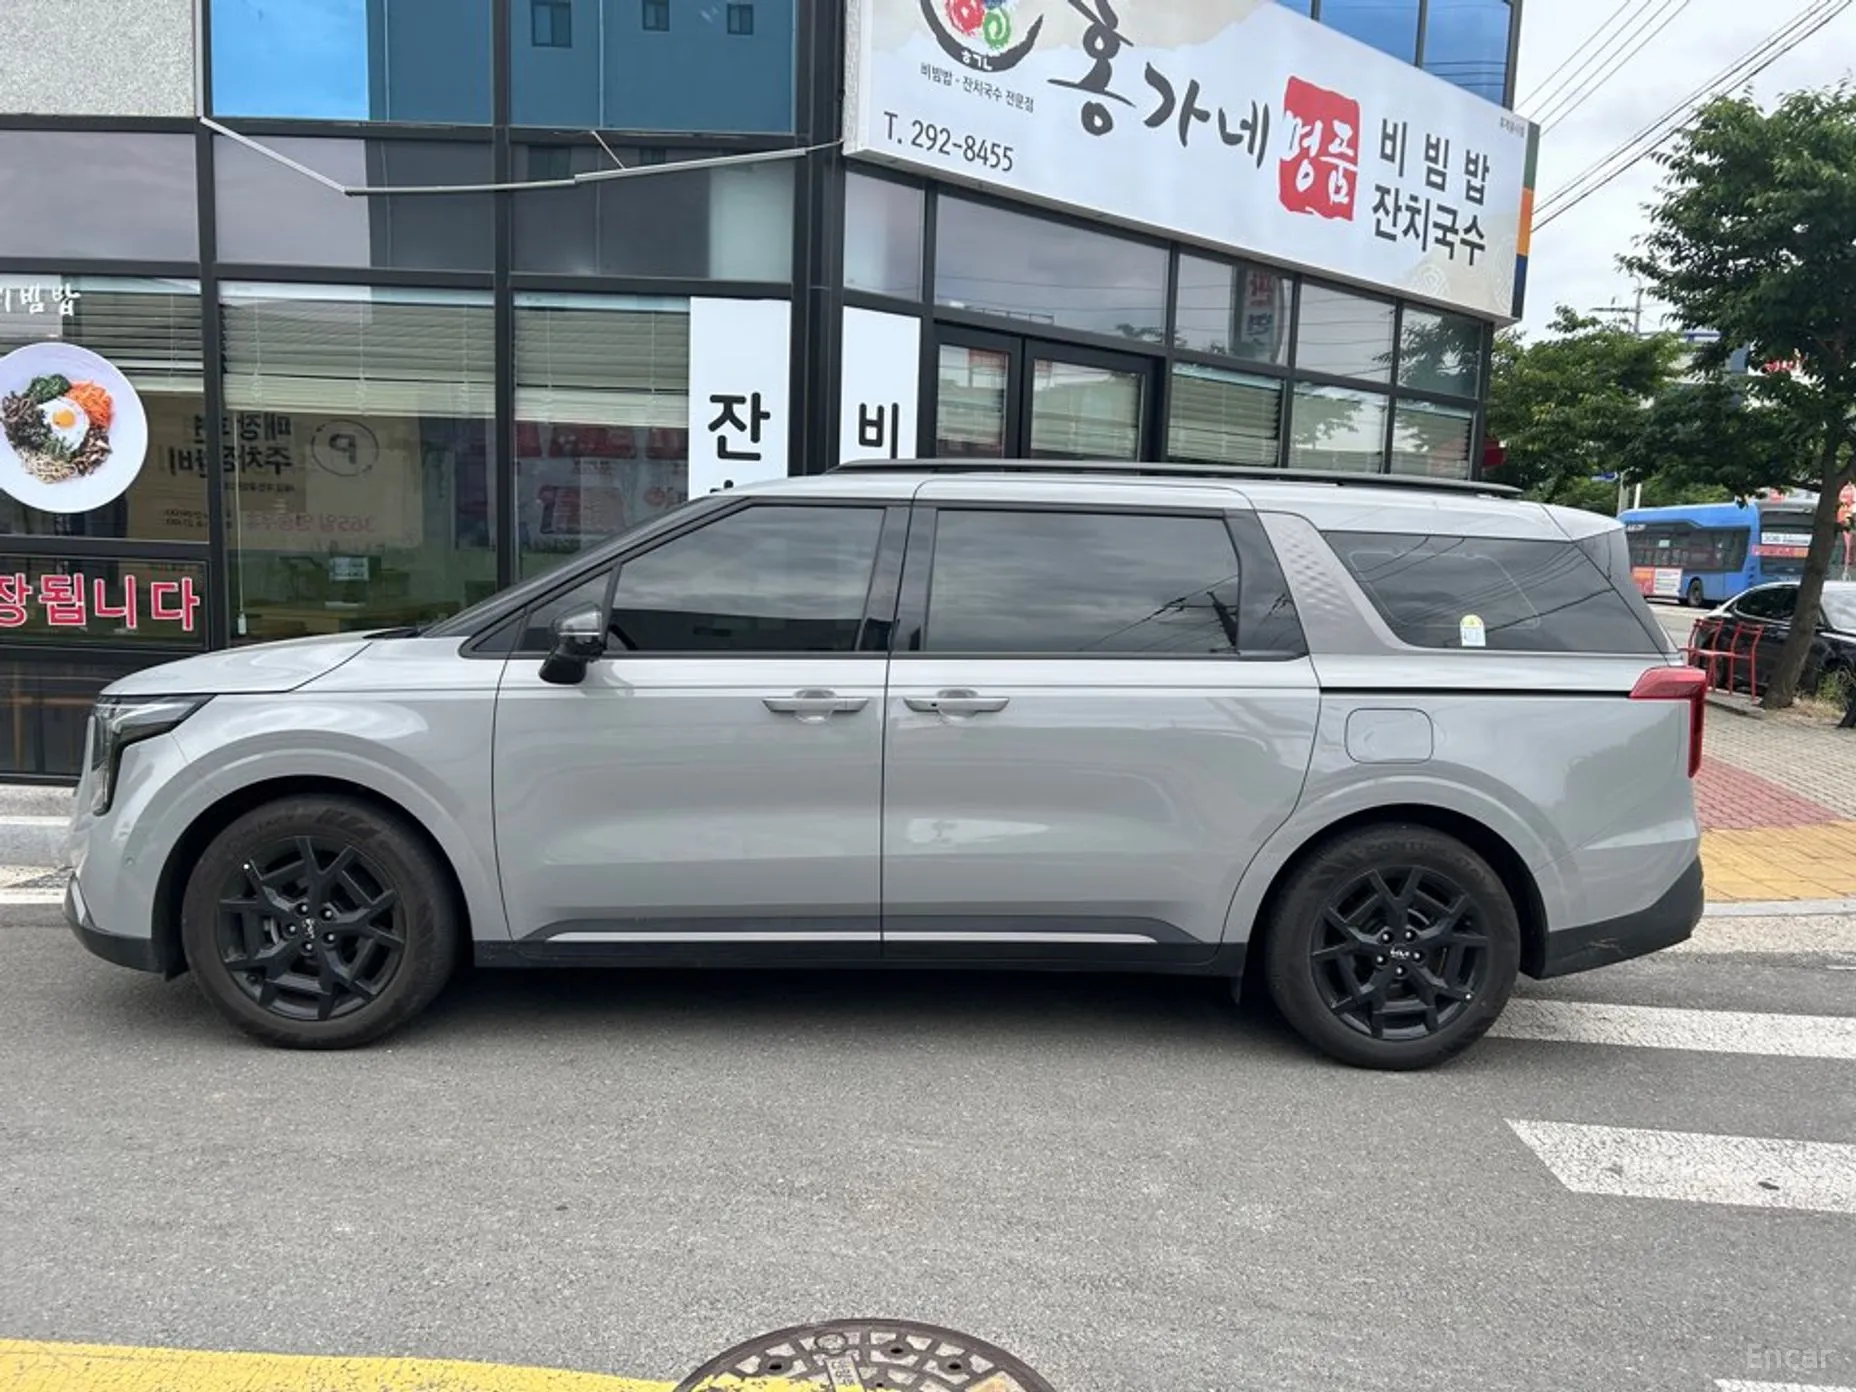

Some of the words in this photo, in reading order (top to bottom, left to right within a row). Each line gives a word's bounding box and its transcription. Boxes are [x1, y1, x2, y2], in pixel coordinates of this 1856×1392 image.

[920, 62, 952, 86] 비빔밥
[963, 75, 1002, 101] 잔치국수
[1005, 90, 1034, 113] 전문점
[1047, 0, 1270, 169] 홍가네
[883, 111, 903, 145] T.
[911, 119, 1014, 173] 292-8455
[1280, 111, 1358, 205] 명품
[1372, 184, 1486, 267] 잔치국수
